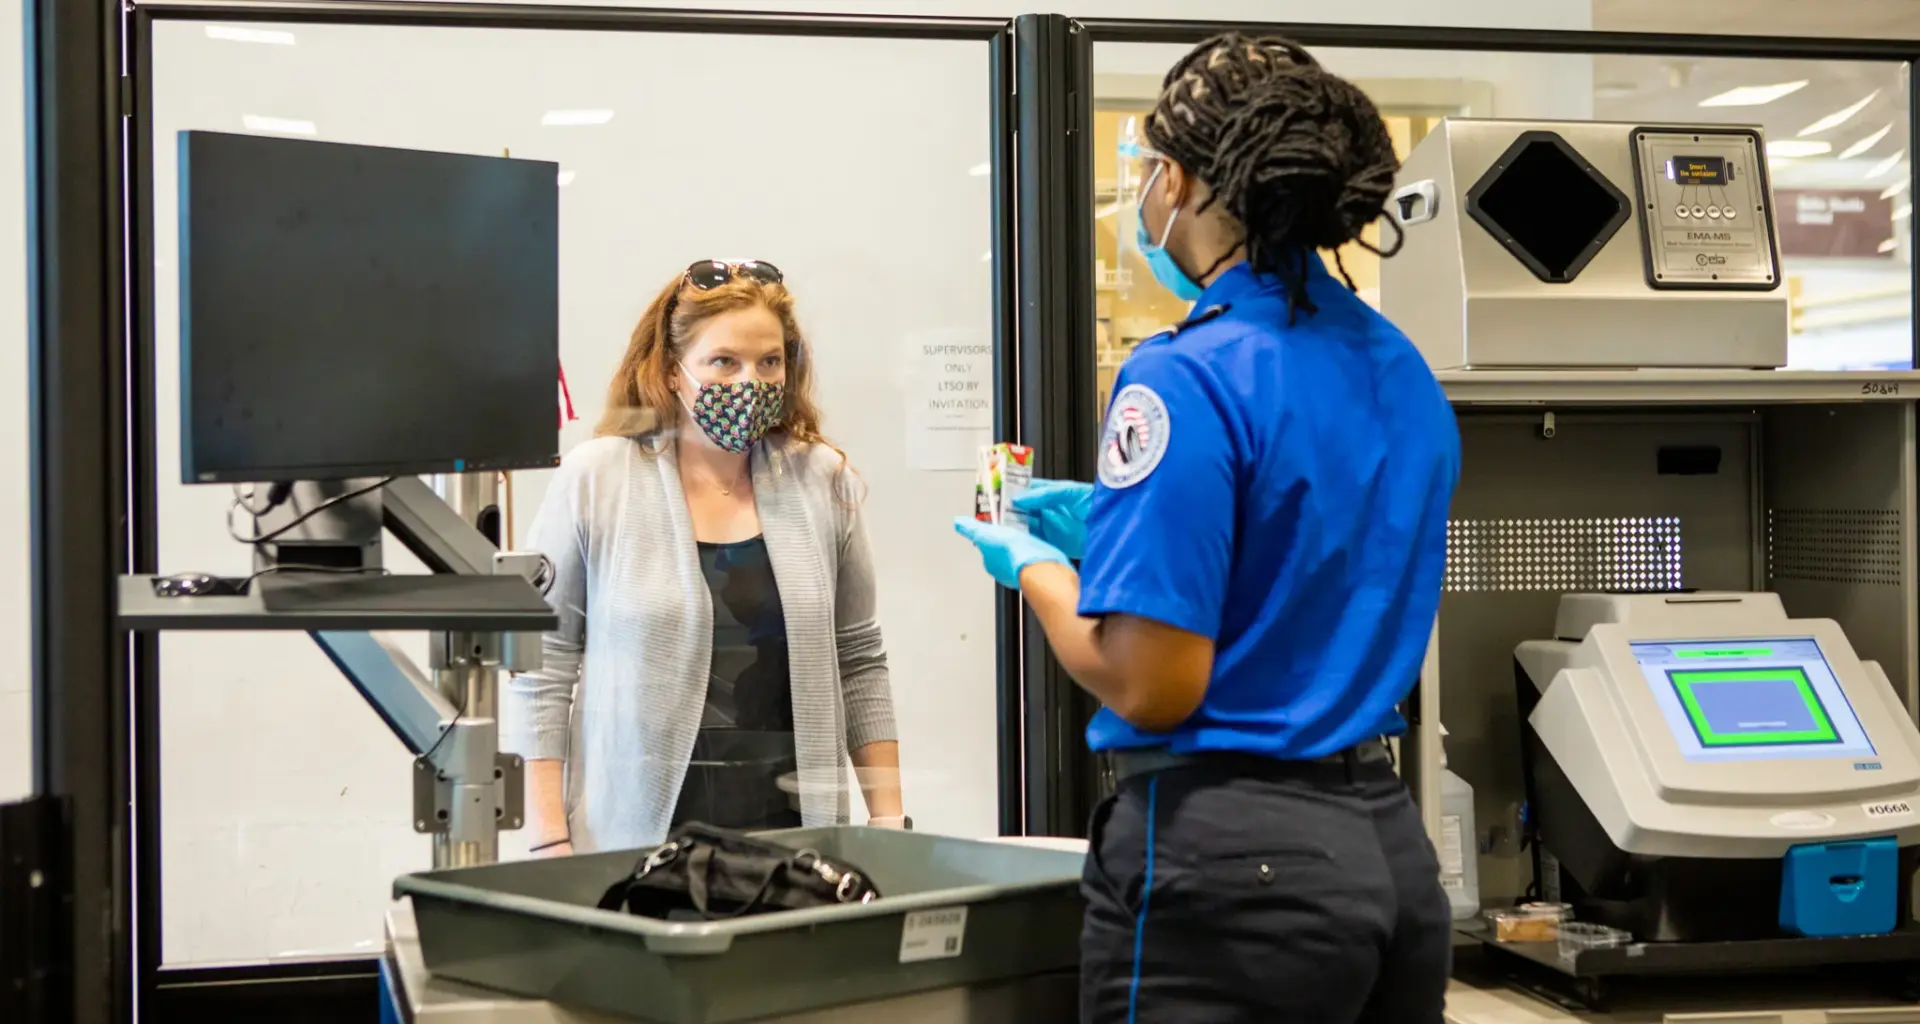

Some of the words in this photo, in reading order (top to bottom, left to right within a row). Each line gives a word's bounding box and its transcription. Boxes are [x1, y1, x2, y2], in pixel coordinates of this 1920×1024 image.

[1687, 232, 1731, 241] EMA-MS
[923, 344, 992, 356] SUPERVISORS
[944, 363, 972, 373] ONLY
[938, 381, 964, 392] LTSO
[966, 381, 979, 391] BY
[929, 399, 989, 410] INVITATION
[1868, 803, 1910, 814] #0668
